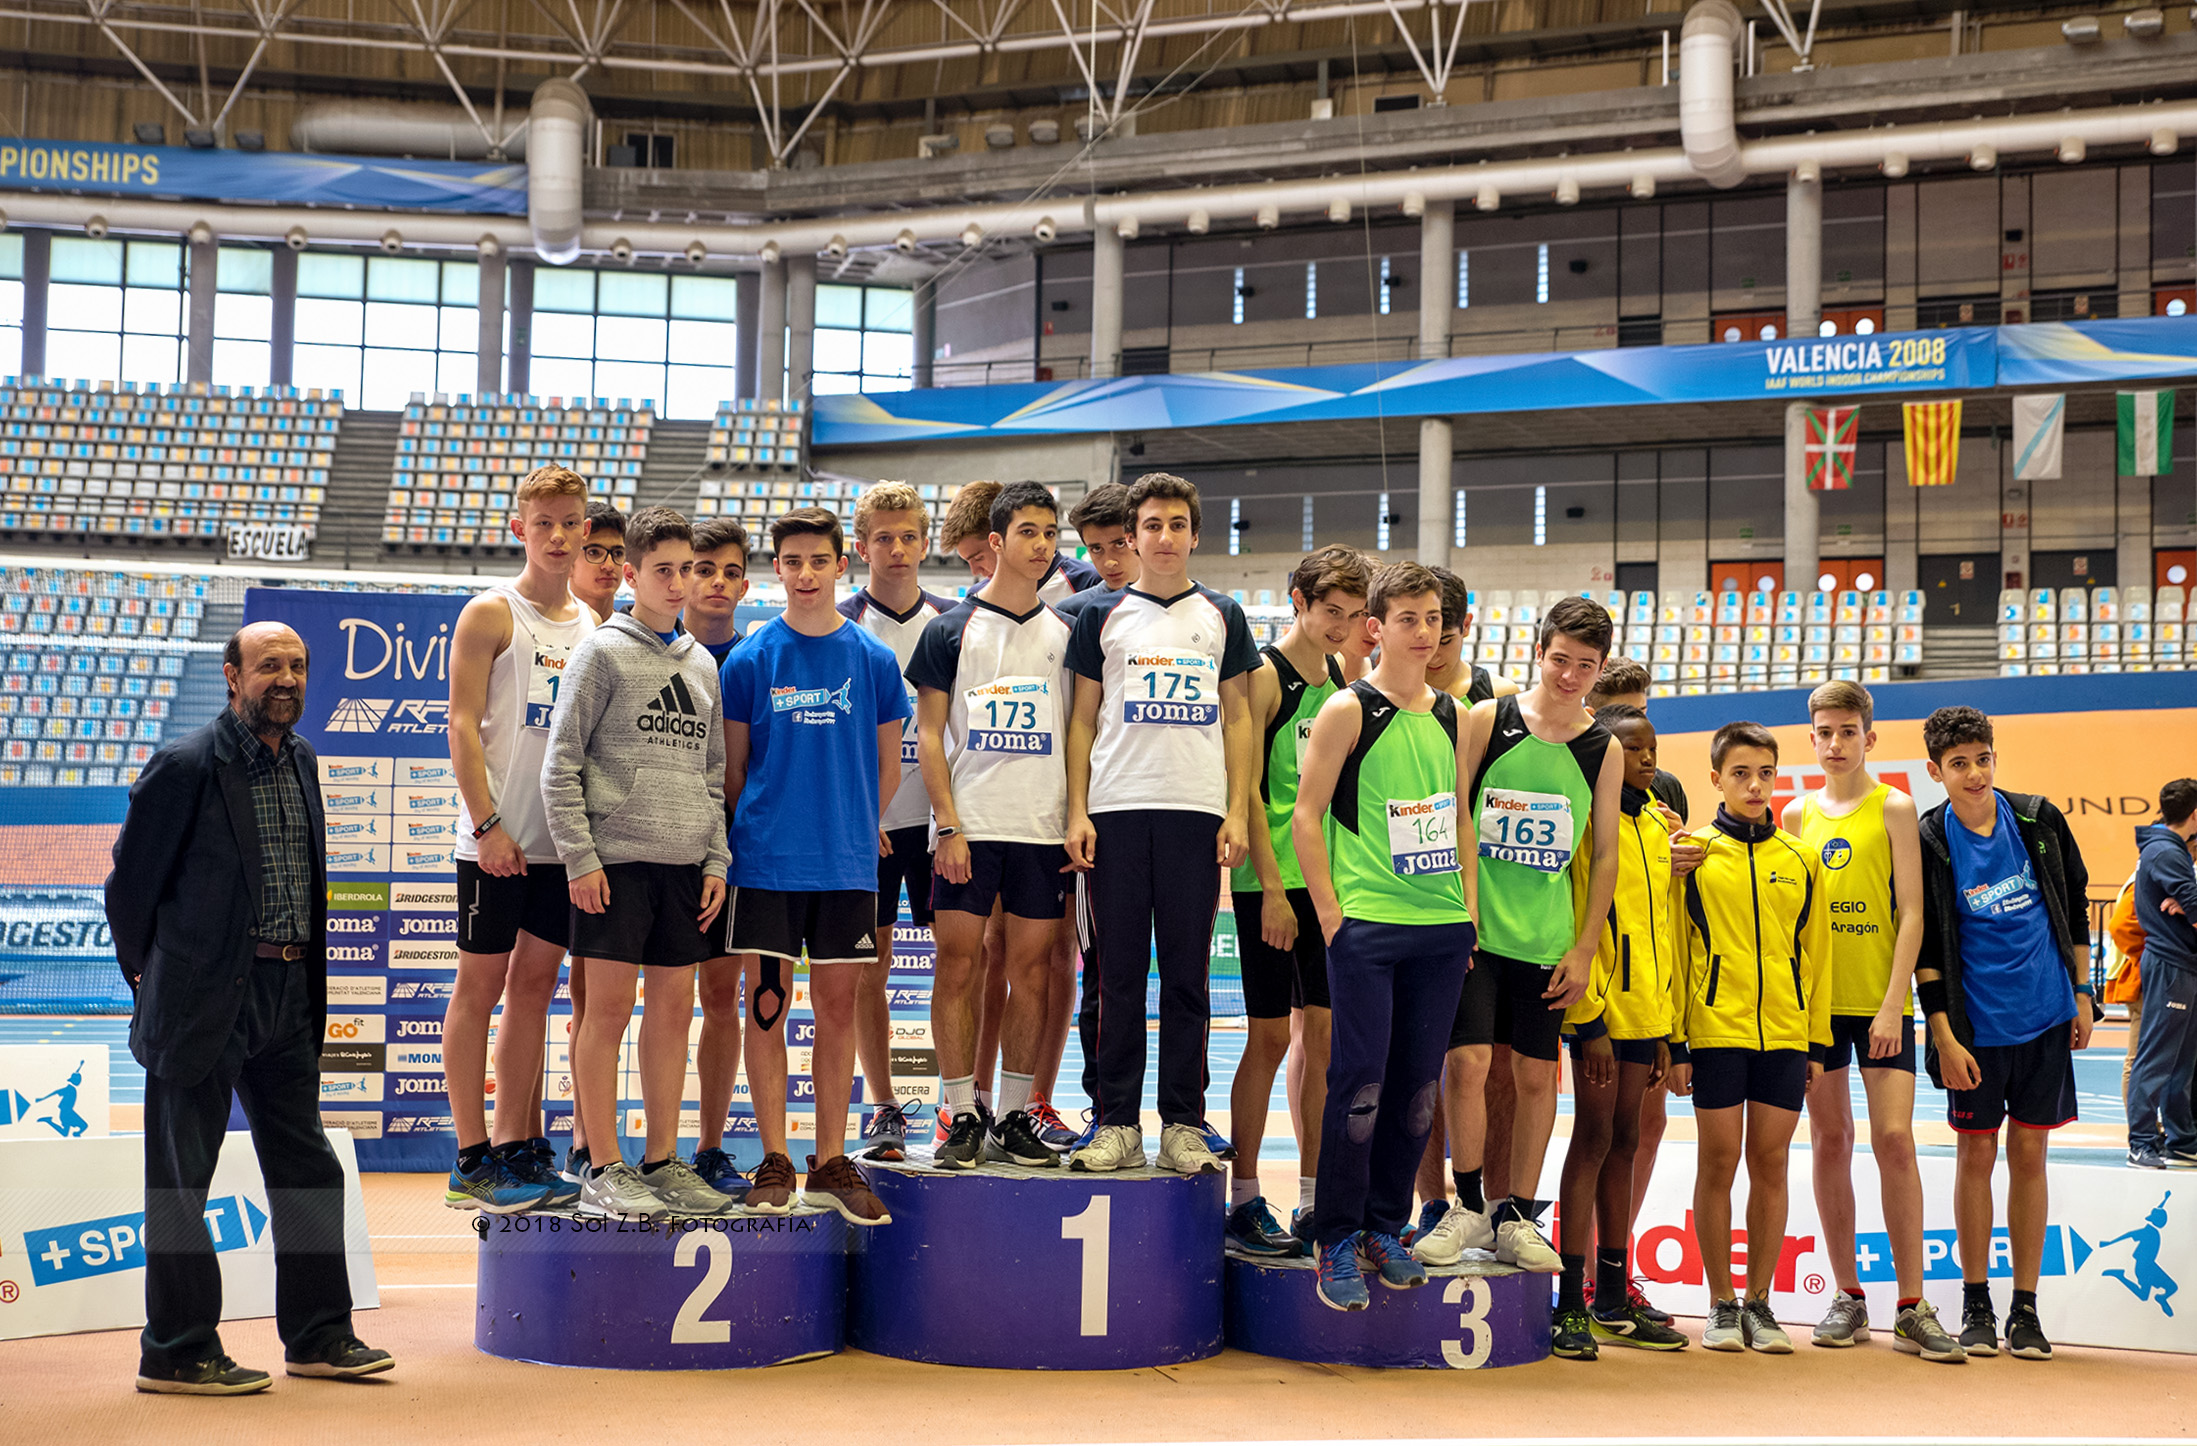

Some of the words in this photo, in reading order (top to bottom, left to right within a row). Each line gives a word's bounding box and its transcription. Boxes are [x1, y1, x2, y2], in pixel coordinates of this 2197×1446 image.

[1765, 341, 1883, 375] VALENCIA
[1888, 337, 1946, 368] 2008
[1789, 374, 1824, 388] WORLD
[1825, 372, 1863, 387] INDOOR
[1863, 367, 1946, 385] CHAMPIONSHIPS
[230, 530, 306, 556] ESCUELA
[1143, 671, 1202, 702] 175
[637, 710, 707, 739] adidas
[985, 700, 1036, 730] 173
[647, 736, 701, 751] ATHLETICS
[1412, 816, 1449, 845] 164
[1496, 815, 1557, 847] 163
[334, 892, 383, 901] IBERDROLA
[1831, 921, 1879, 936] Aragón
[328, 1022, 358, 1039] GO
[354, 1017, 365, 1027] fit
[896, 1027, 926, 1035] DJO
[1061, 1194, 1110, 1337] 1
[670, 1226, 733, 1344] 2
[1441, 1275, 1492, 1370] 3
